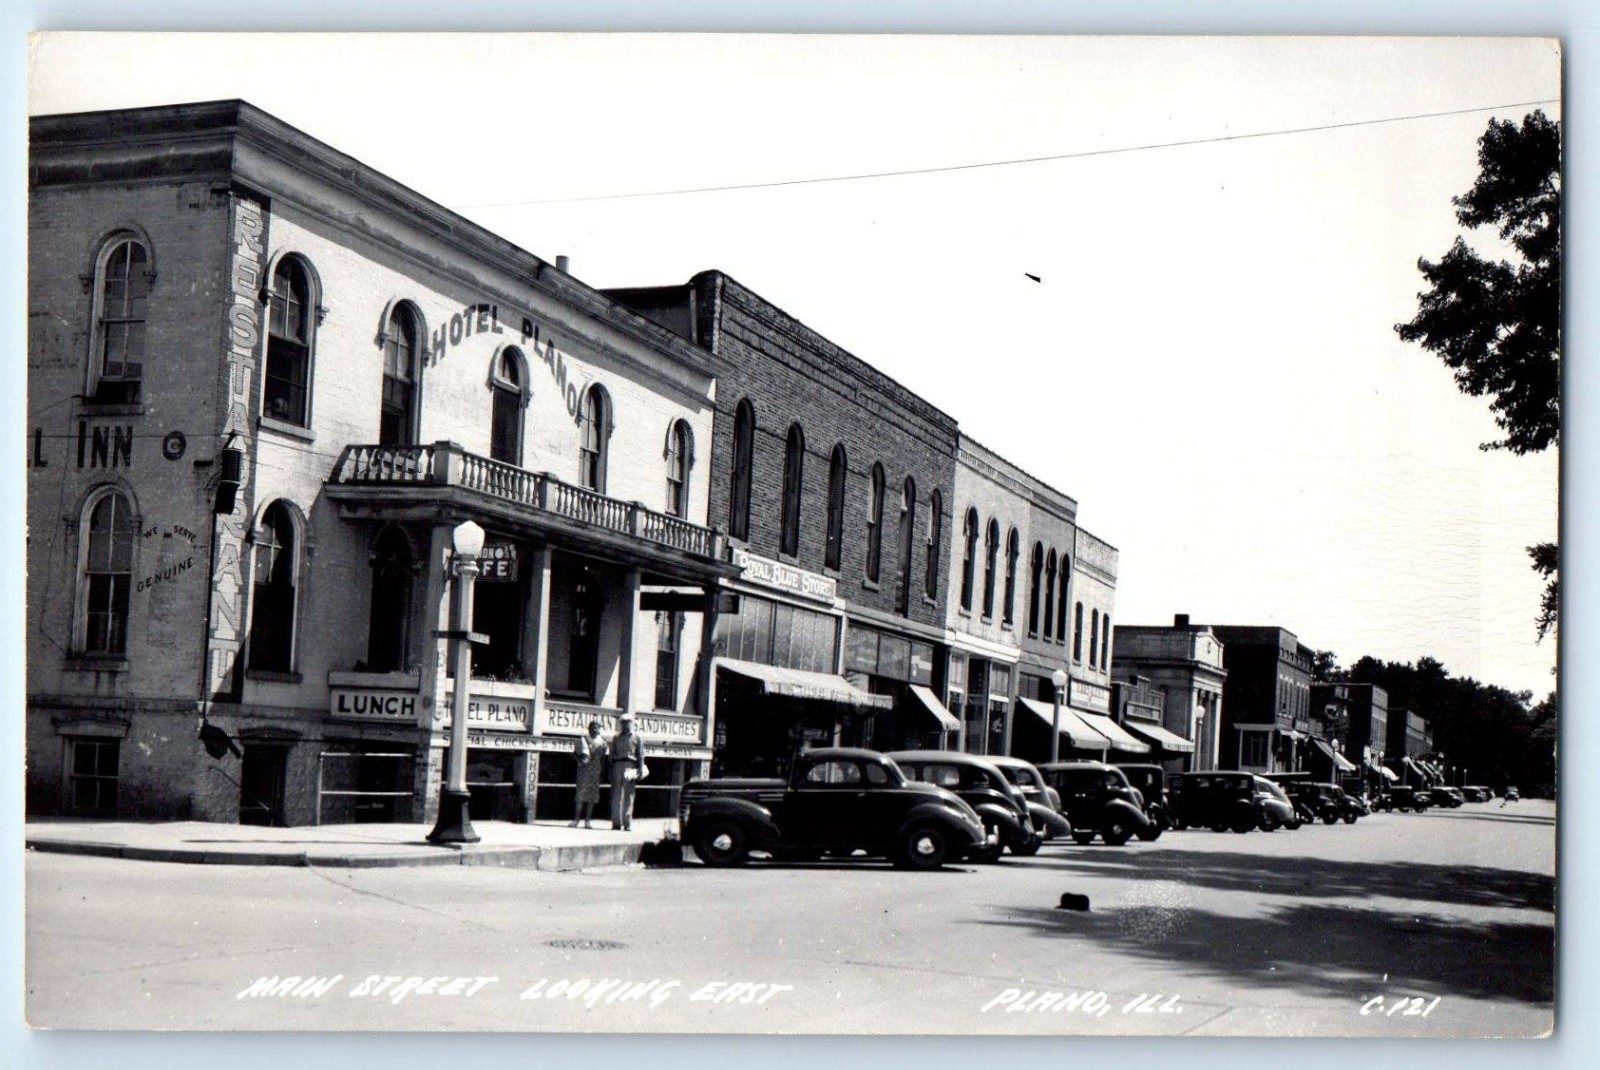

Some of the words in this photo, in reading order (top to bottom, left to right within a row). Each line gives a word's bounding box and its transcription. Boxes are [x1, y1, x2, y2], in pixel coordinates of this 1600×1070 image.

[431, 303, 503, 368] HOTEL
[521, 317, 577, 417] PLANO
[77, 421, 133, 468] INN
[143, 526, 158, 539] WE
[173, 524, 197, 543] SERVE
[137, 556, 193, 592] GENUINE
[453, 560, 508, 576] CFE
[739, 554, 772, 579] ROYAL
[772, 564, 799, 588] BLUE
[801, 574, 832, 596] STORE
[338, 694, 415, 716] LUNCH
[444, 700, 483, 721] HEL
[488, 703, 527, 723] PLANO
[634, 717, 697, 736] SANDWICHES
[494, 737, 537, 748] CHICKEN
[551, 740, 574, 751] STEA
